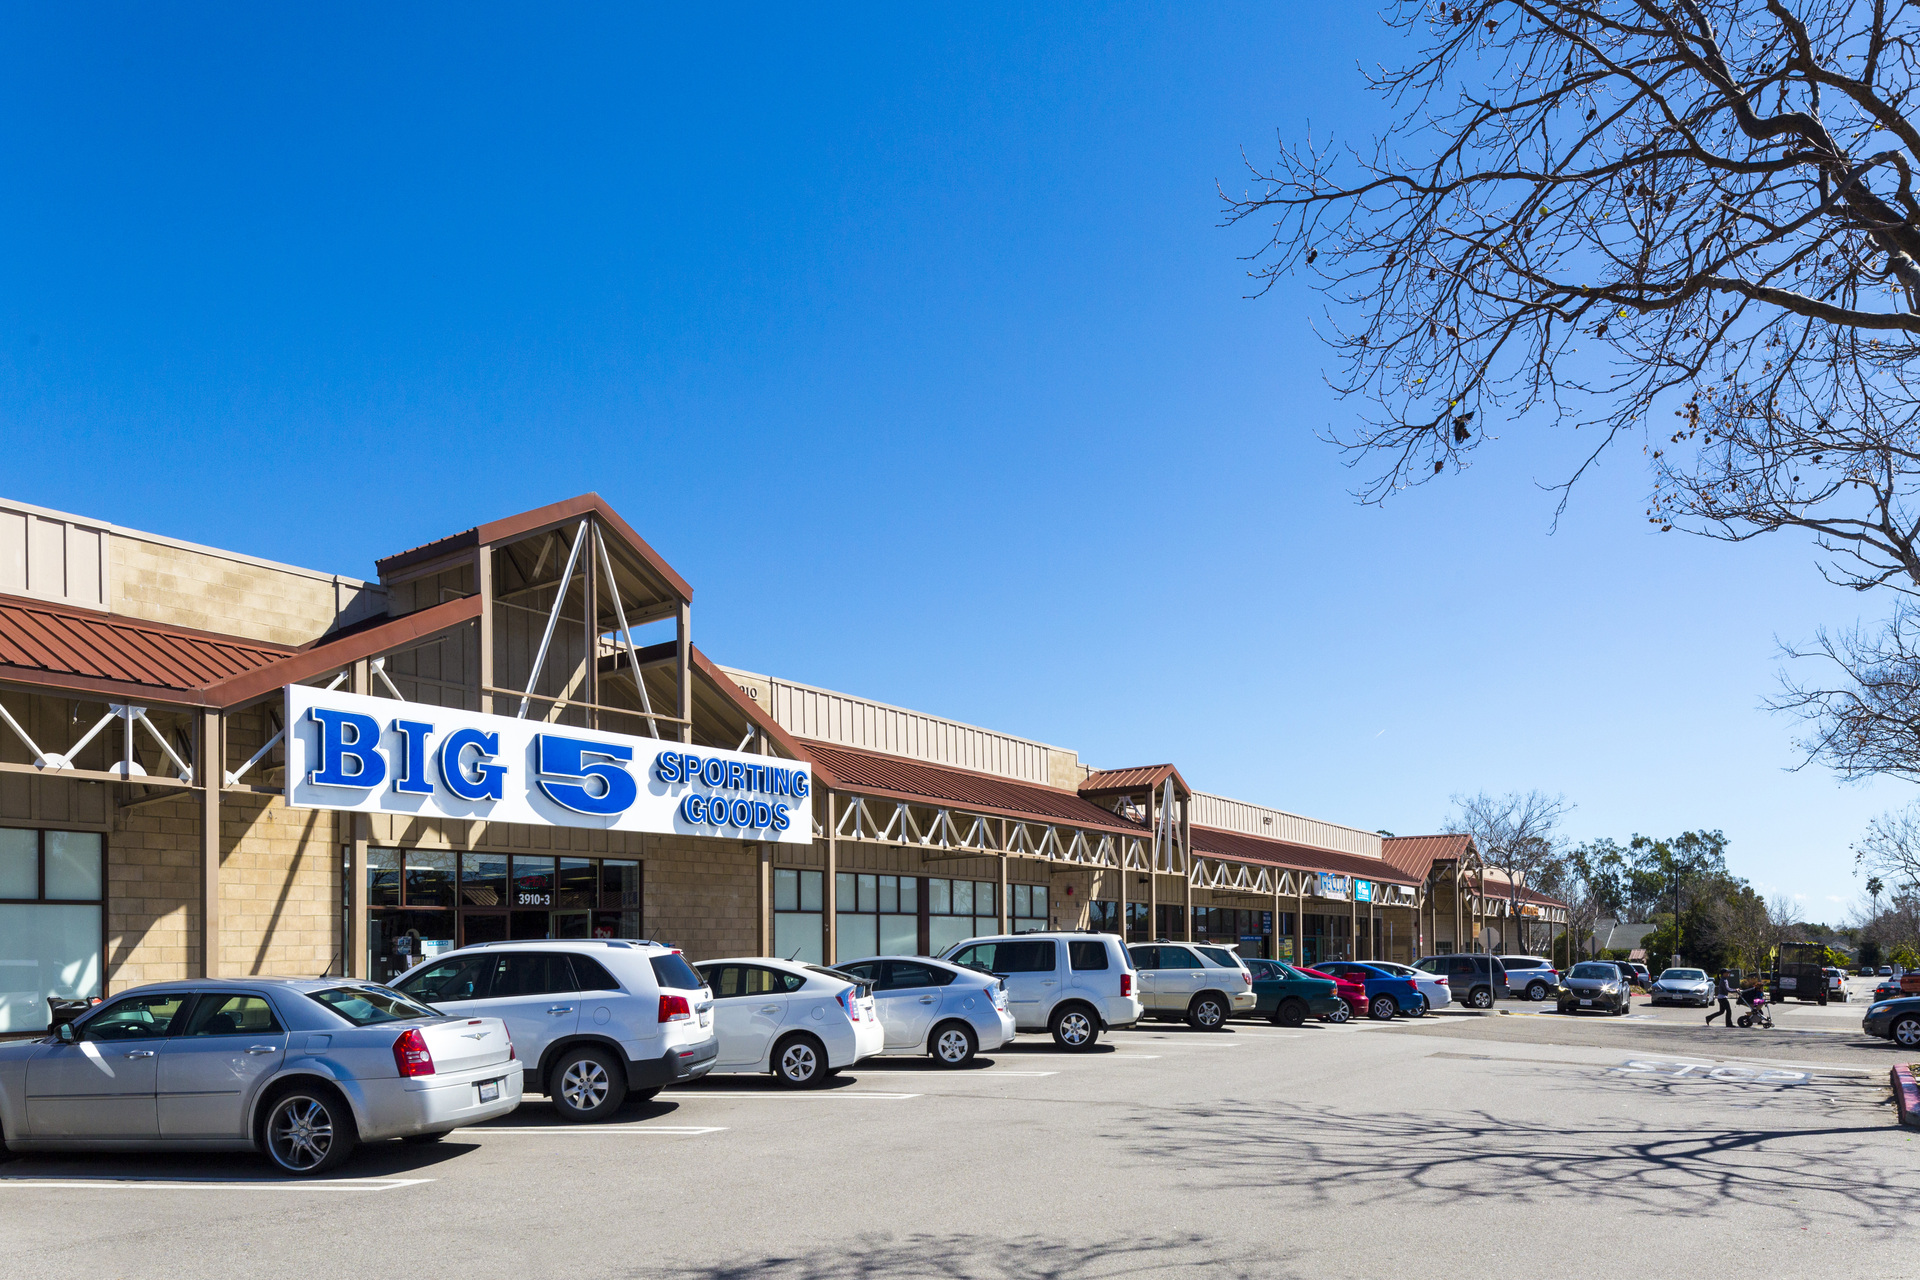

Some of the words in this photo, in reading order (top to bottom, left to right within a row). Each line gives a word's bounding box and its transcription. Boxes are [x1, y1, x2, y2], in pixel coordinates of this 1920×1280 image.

[309, 706, 509, 801] BIG
[536, 733, 638, 816] 5
[656, 751, 810, 798] SPORTING
[681, 793, 791, 832] GOODS
[520, 876, 547, 887] OPEN
[518, 893, 550, 905] 3910-3
[1615, 1060, 1808, 1082] STOP
